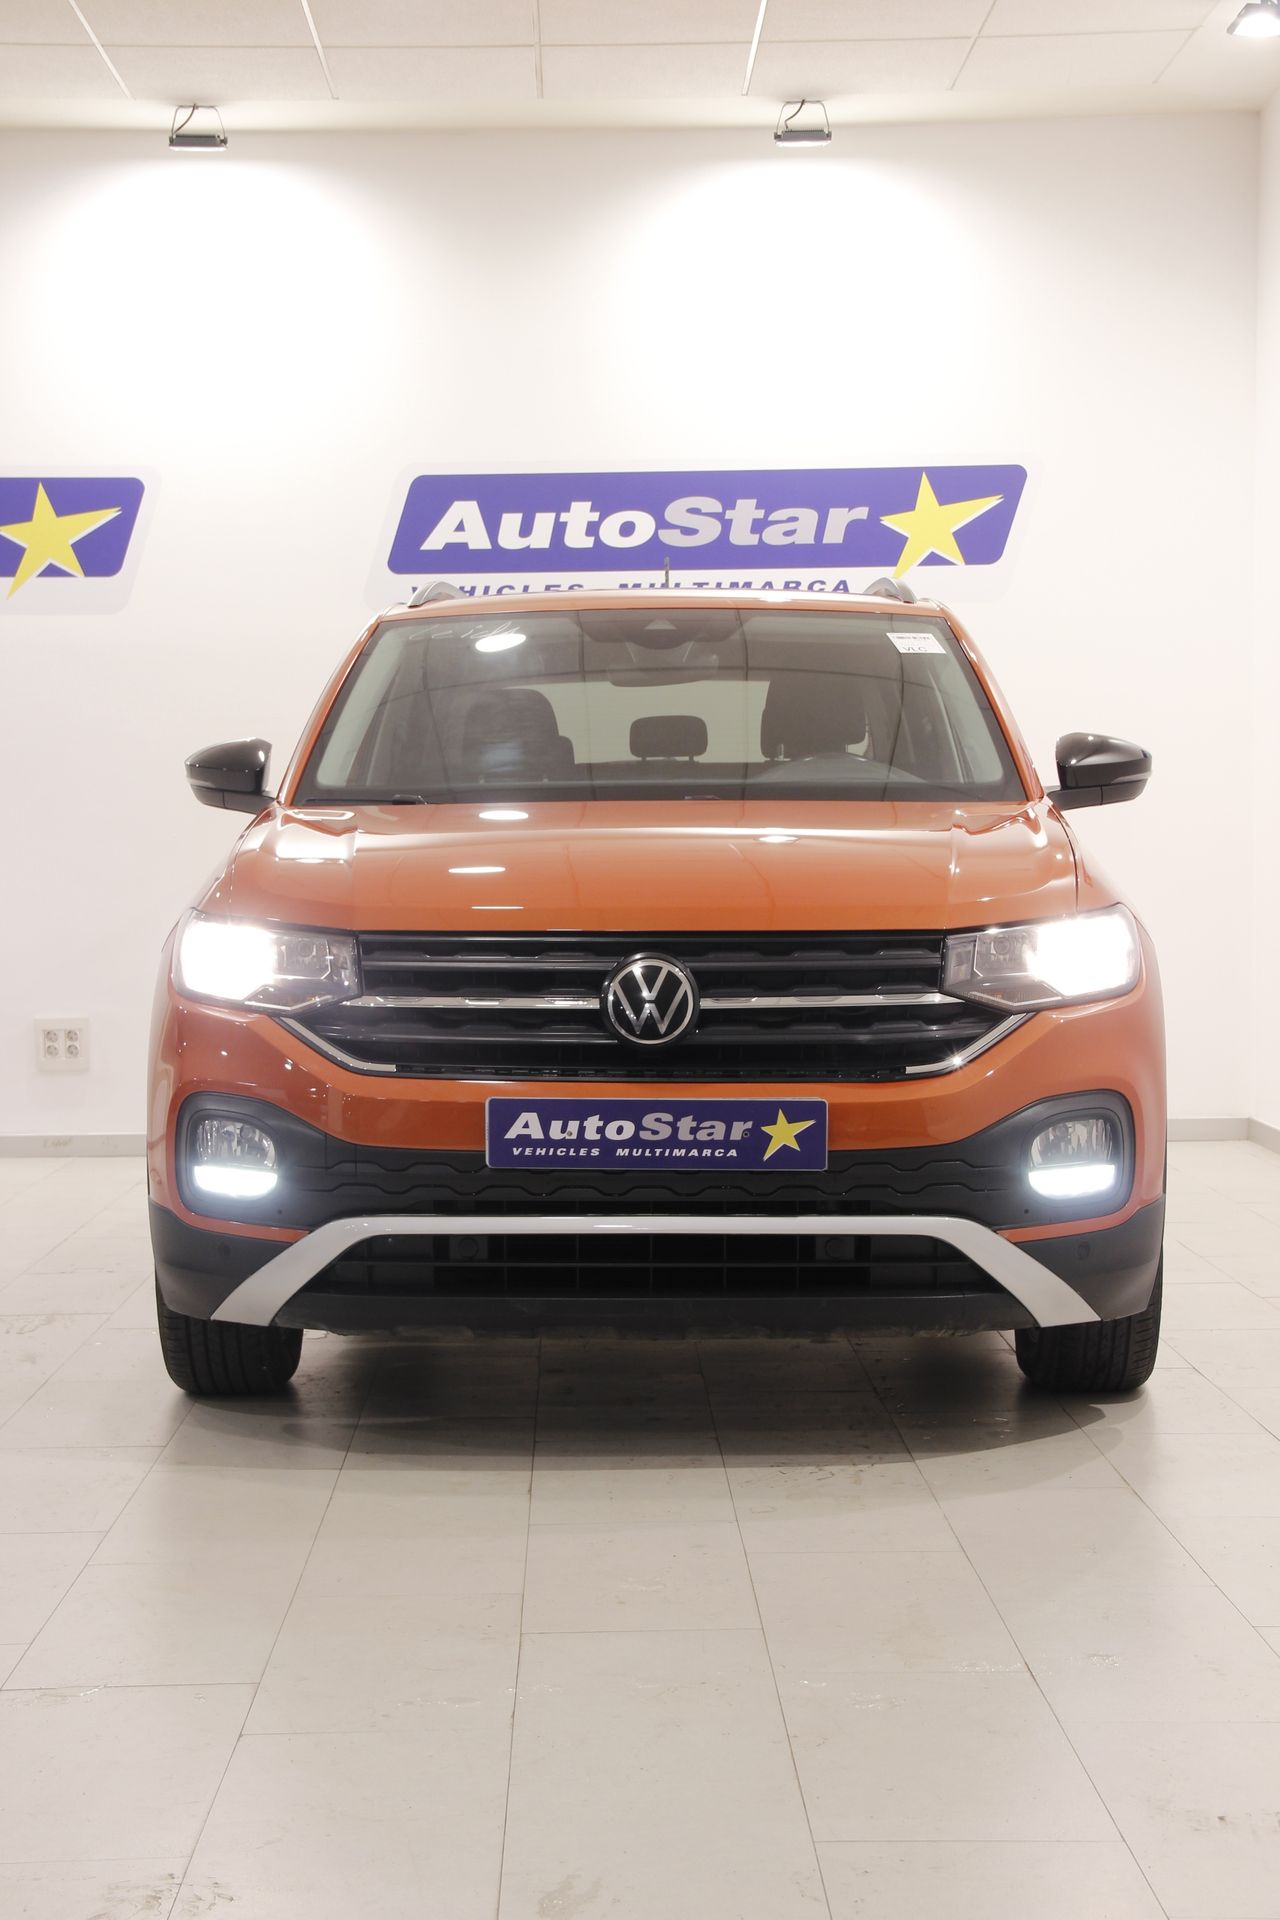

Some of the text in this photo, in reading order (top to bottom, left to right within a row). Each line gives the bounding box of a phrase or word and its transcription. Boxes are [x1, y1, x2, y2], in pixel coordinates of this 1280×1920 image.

[419, 496, 869, 552] AutoStar
[612, 964, 689, 1036] VW
[503, 1111, 753, 1142] AutoStar
[512, 1147, 738, 1158] VEHICLES MULTIMARCA
